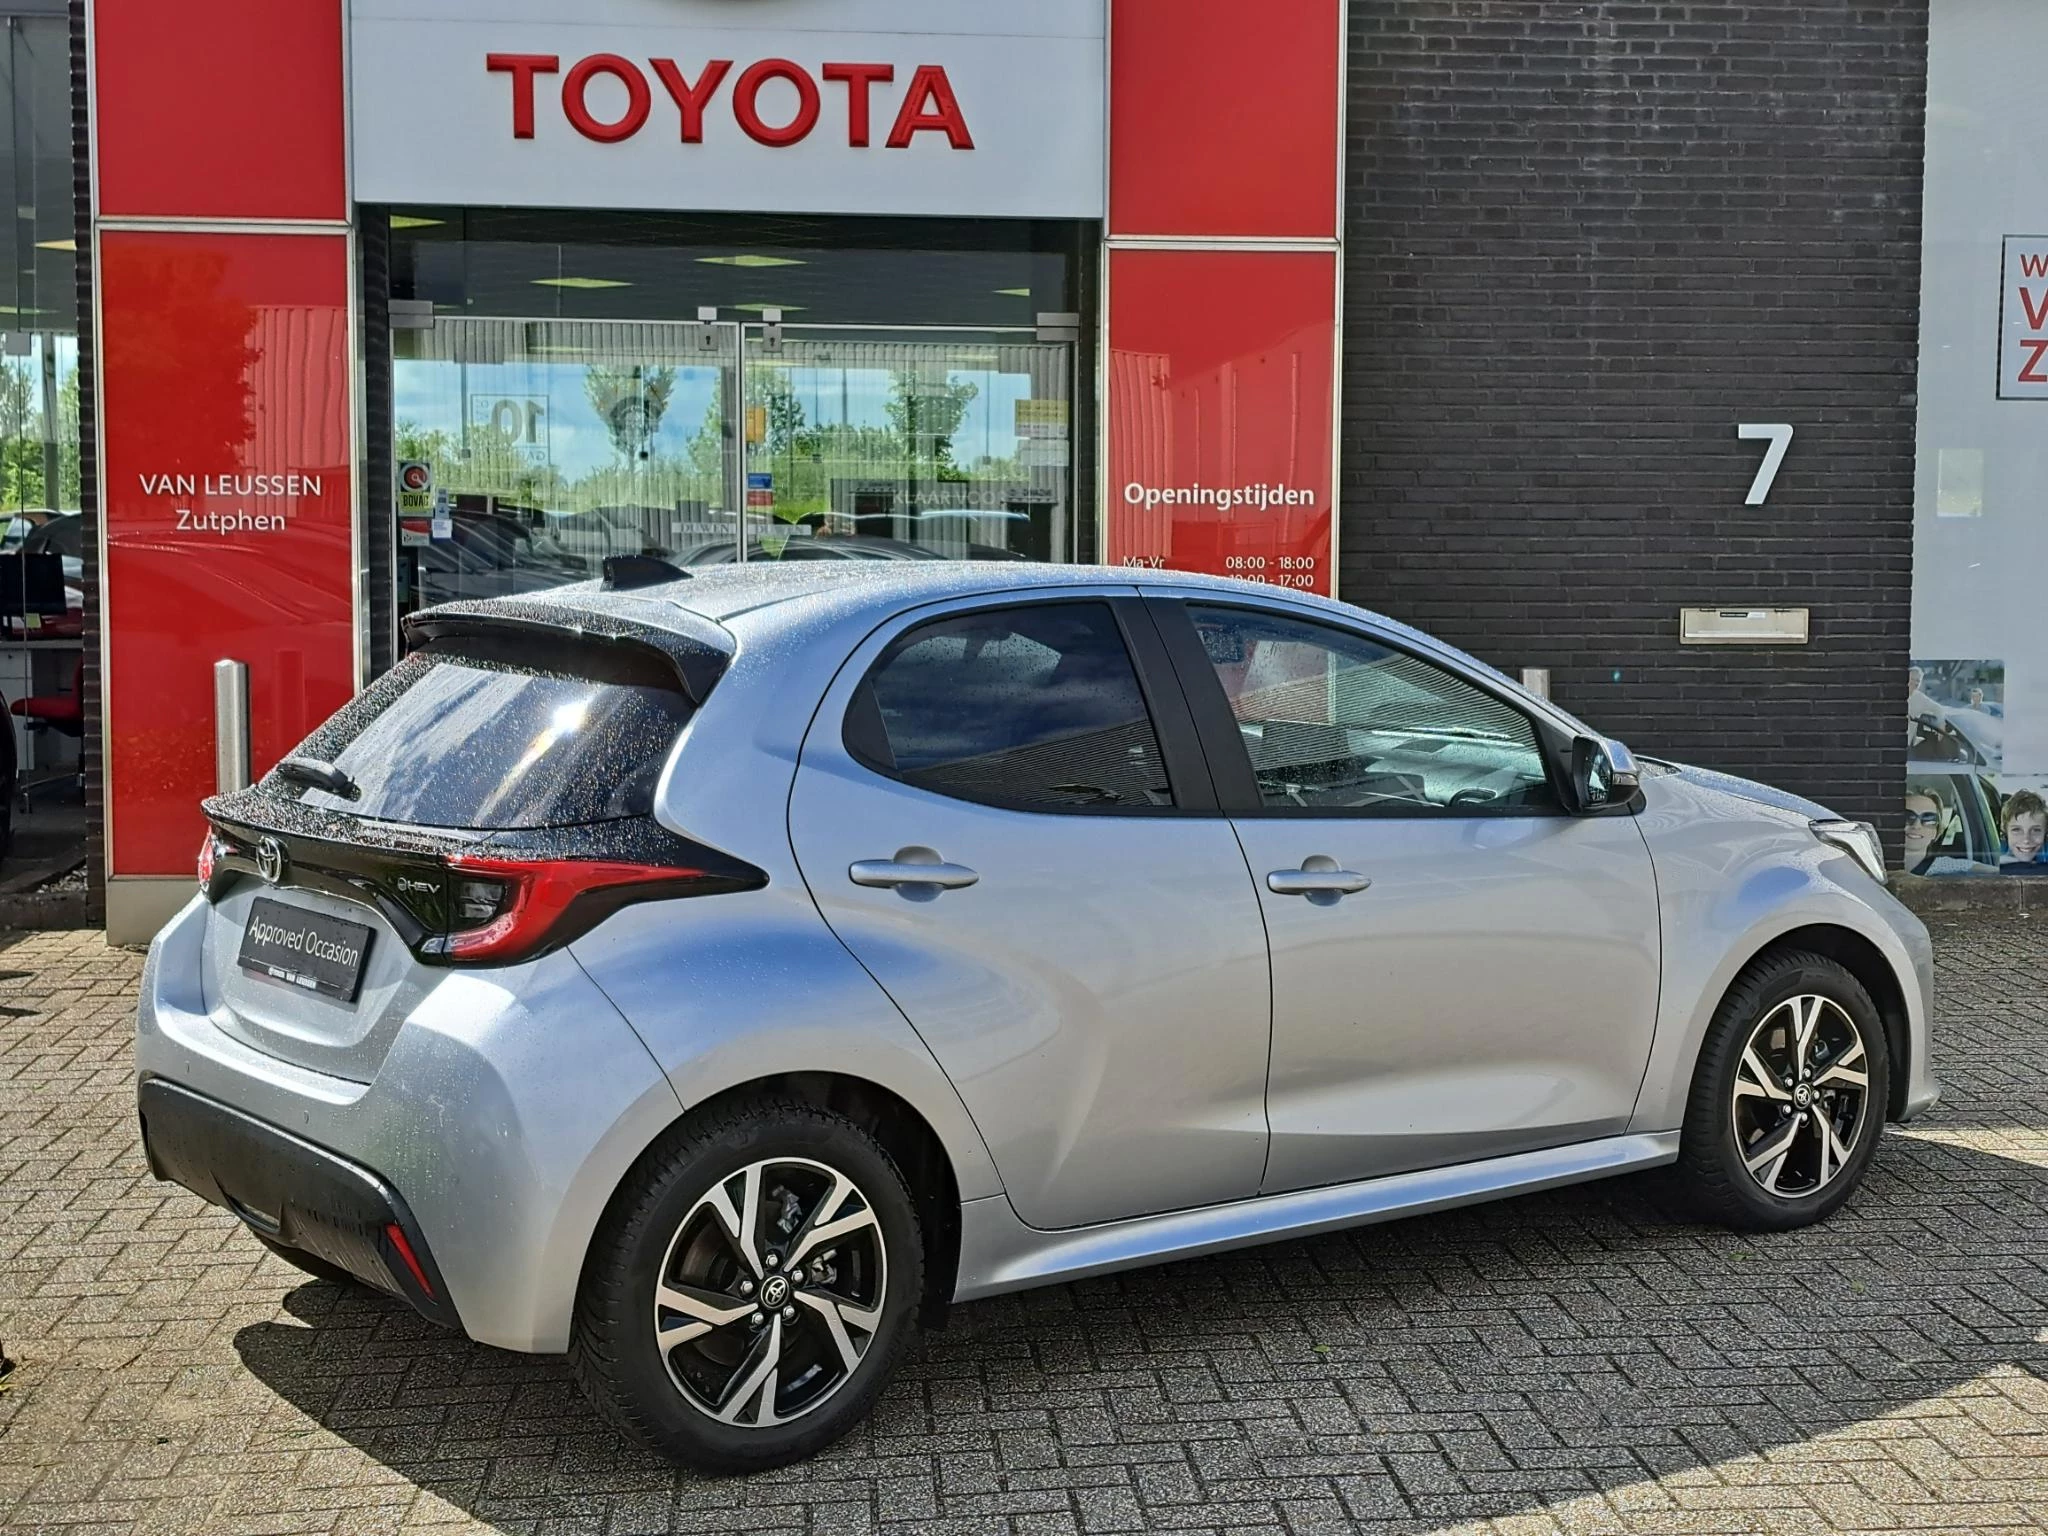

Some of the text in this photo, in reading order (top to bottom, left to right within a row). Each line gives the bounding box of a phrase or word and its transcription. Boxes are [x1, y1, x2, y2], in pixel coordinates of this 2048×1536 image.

[486, 53, 975, 150] TOYOTA
[1737, 423, 1794, 505] 7
[138, 474, 322, 497] VAN LEUSSEN
[1124, 482, 1315, 511] Openingstijden
[175, 508, 286, 536] Zutphen
[1123, 555, 1165, 569] Ma-Vr
[1225, 556, 1266, 569] 08:00
[1278, 556, 1314, 569] 18:00
[1278, 574, 1314, 587] 17:00
[248, 915, 358, 967] Approved Occasion
